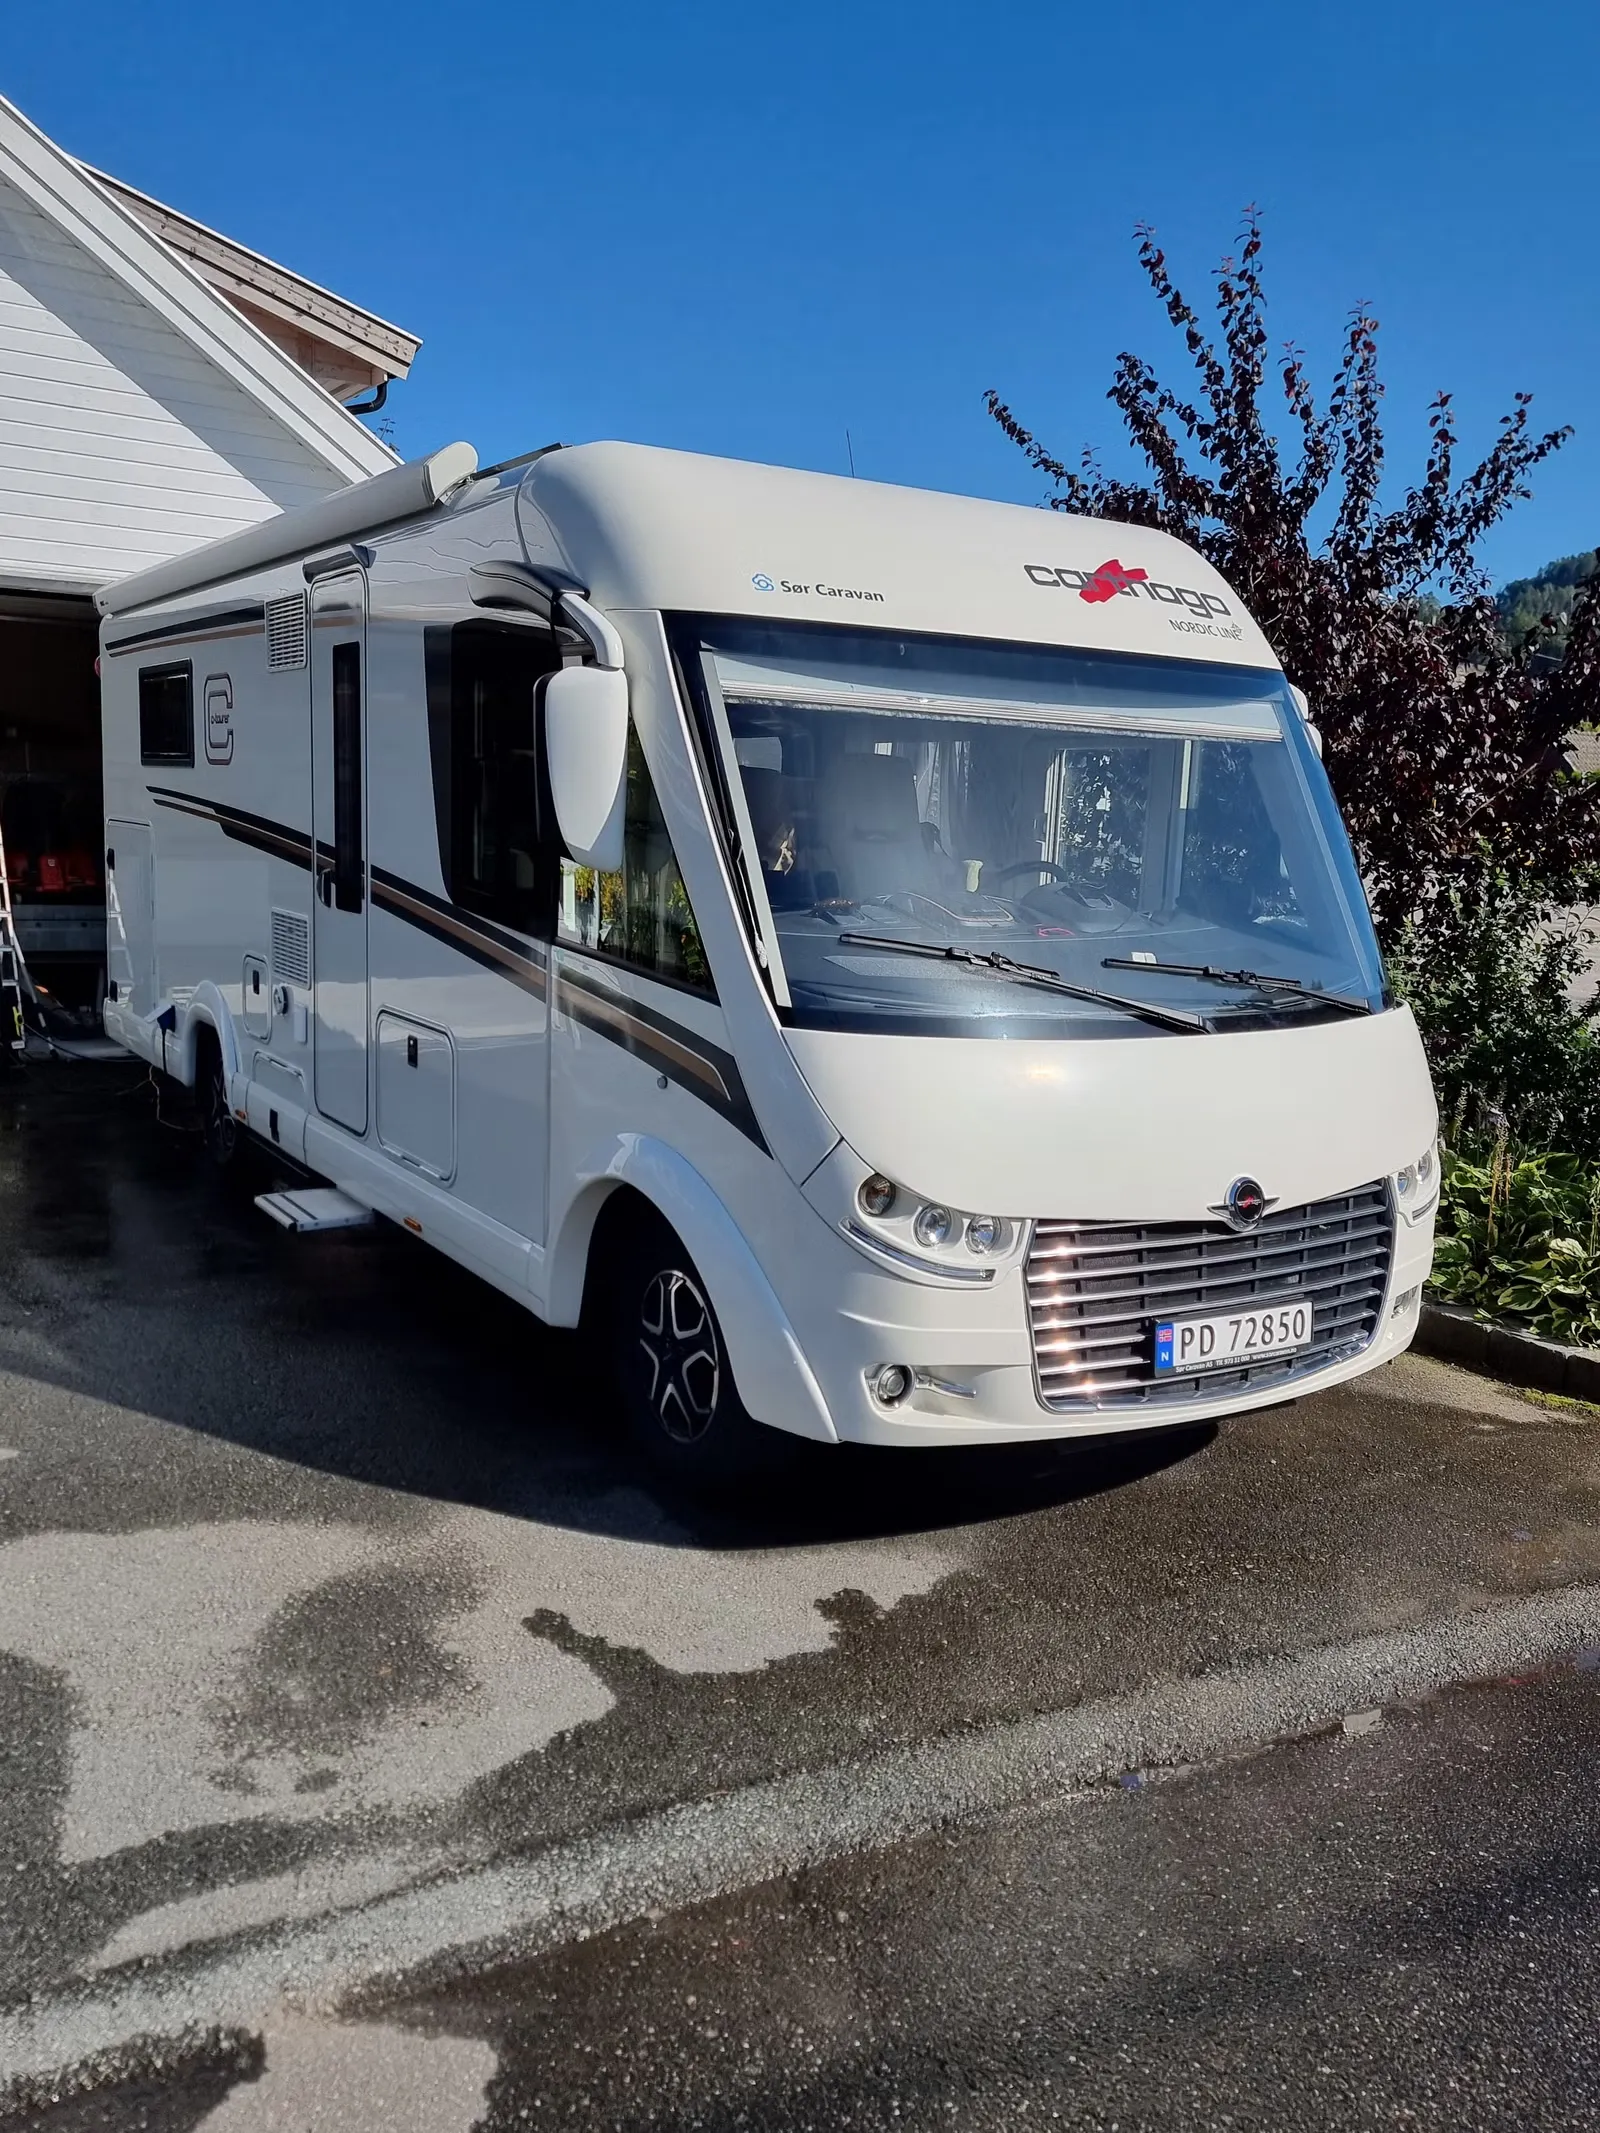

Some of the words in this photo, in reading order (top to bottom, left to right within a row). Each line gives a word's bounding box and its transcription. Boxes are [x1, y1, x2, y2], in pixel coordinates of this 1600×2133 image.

[780, 580, 811, 595] Sør
[815, 583, 885, 602] Caravan
[1024, 564, 1231, 619] carthago
[1169, 619, 1218, 637] NORDIC
[1218, 627, 1243, 641] LINE
[1180, 1323, 1216, 1360] PD
[1229, 1308, 1306, 1353] 72850
[1160, 1351, 1170, 1362] N
[1205, 1360, 1213, 1368] AS
